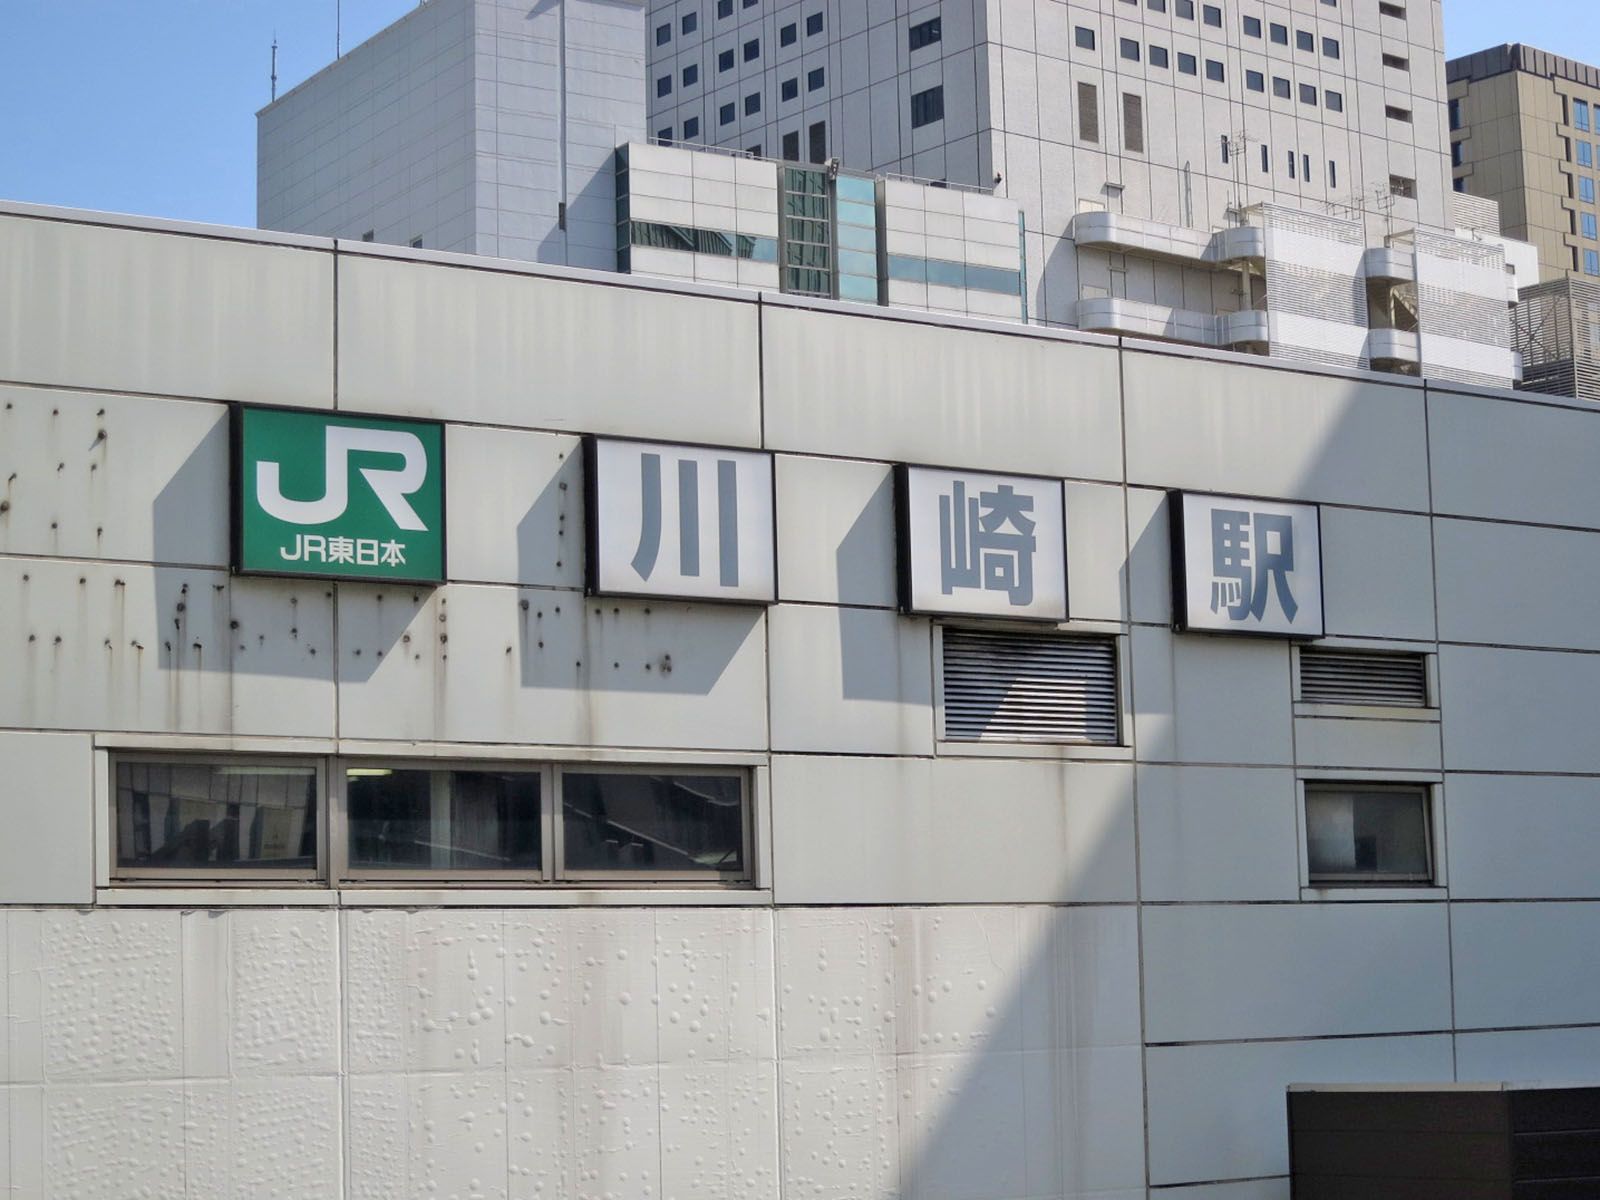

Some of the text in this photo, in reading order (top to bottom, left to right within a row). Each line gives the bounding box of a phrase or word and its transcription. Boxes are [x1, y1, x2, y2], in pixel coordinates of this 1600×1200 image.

[256, 424, 429, 532] JR
[279, 533, 407, 568] JR東日本
